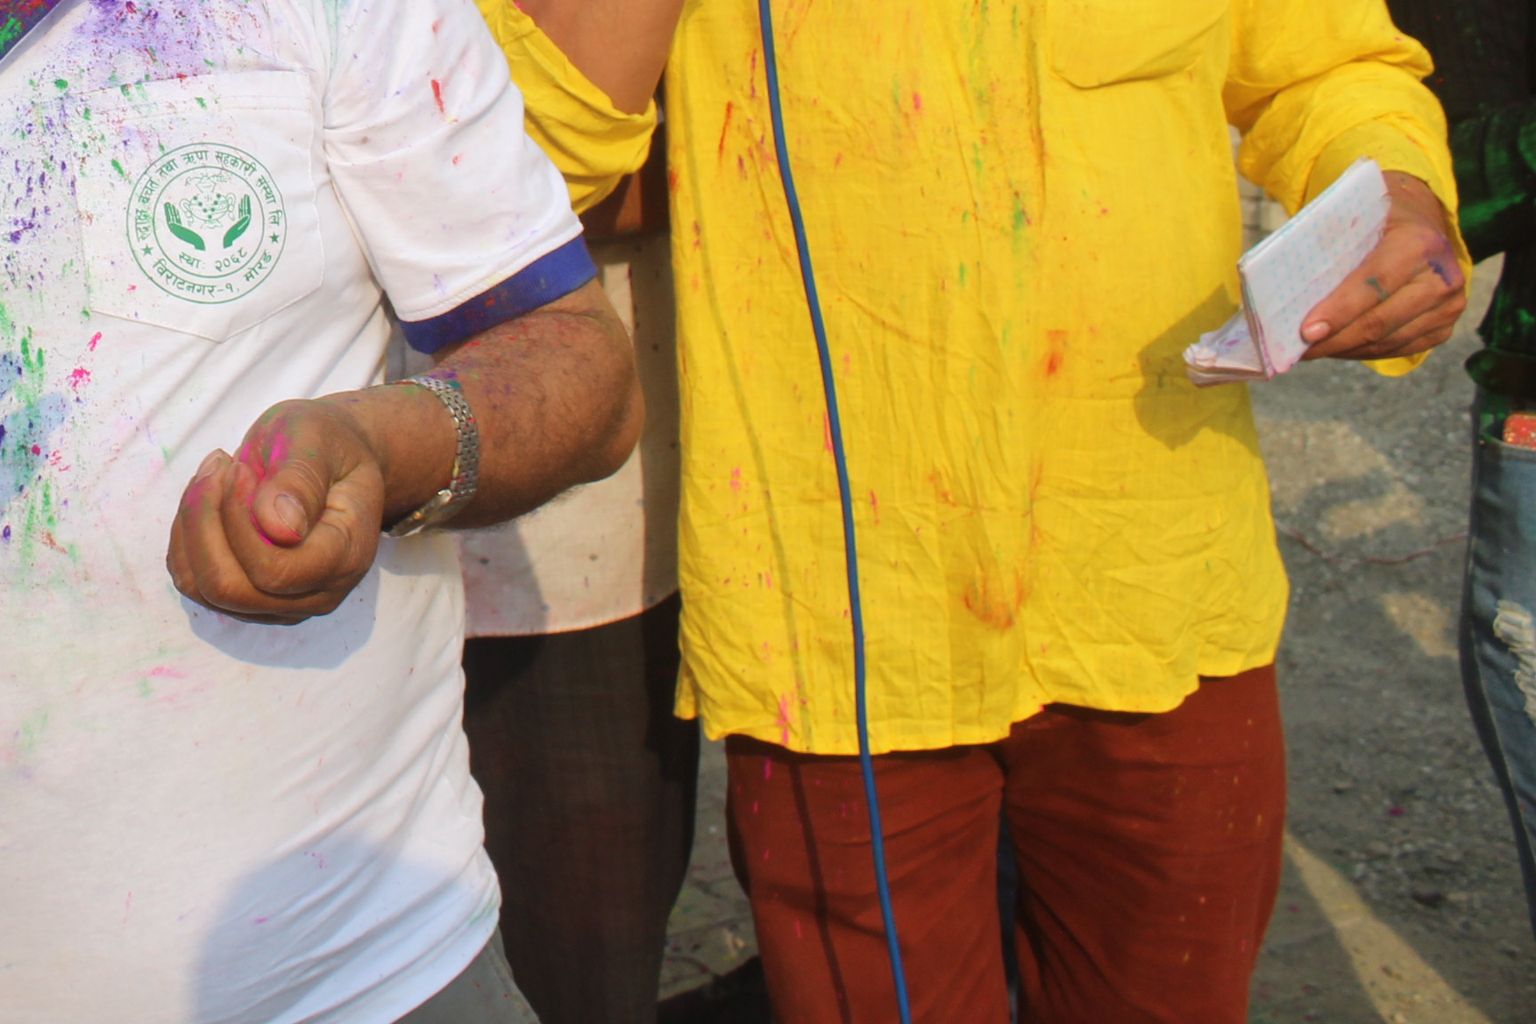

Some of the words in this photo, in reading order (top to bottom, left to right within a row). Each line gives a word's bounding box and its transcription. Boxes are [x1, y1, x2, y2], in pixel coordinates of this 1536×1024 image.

[138, 176, 160, 204] बचत
[155, 159, 181, 177] तथा
[180, 150, 208, 165] ऋण
[215, 150, 257, 177] सहकारी
[215, 247, 248, 272] २०६८
